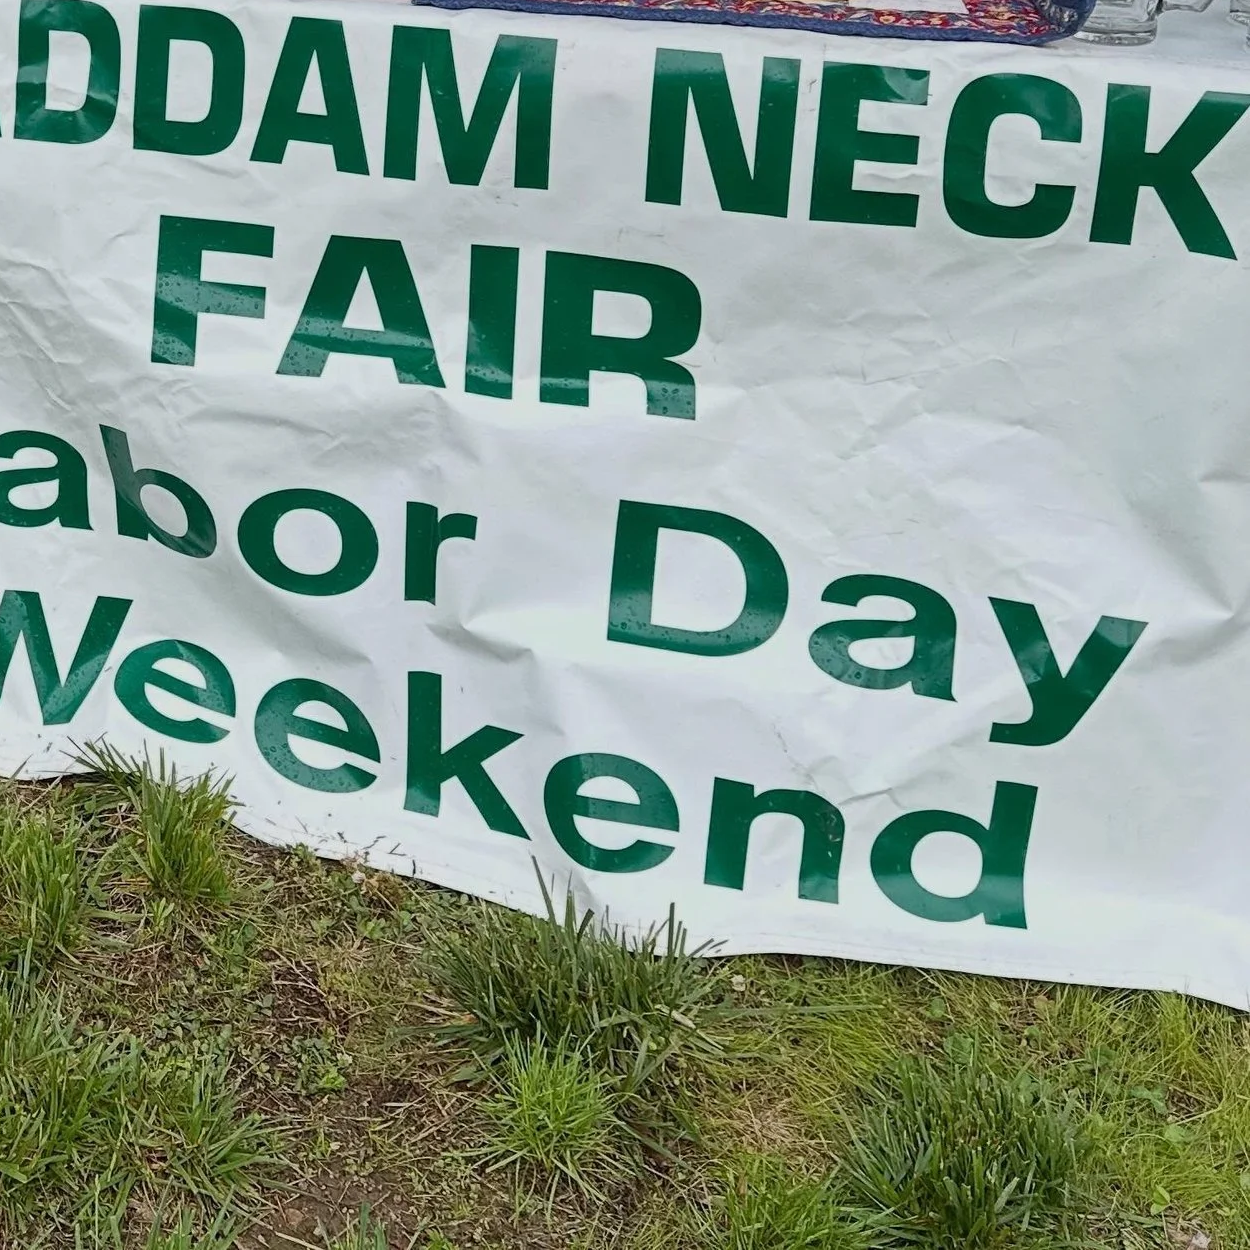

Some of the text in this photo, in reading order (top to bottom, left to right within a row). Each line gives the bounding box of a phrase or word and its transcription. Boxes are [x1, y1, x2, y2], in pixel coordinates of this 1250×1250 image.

[644, 47, 1250, 261] NECK
[150, 214, 703, 420] FAIR
[606, 498, 1148, 748] Day
